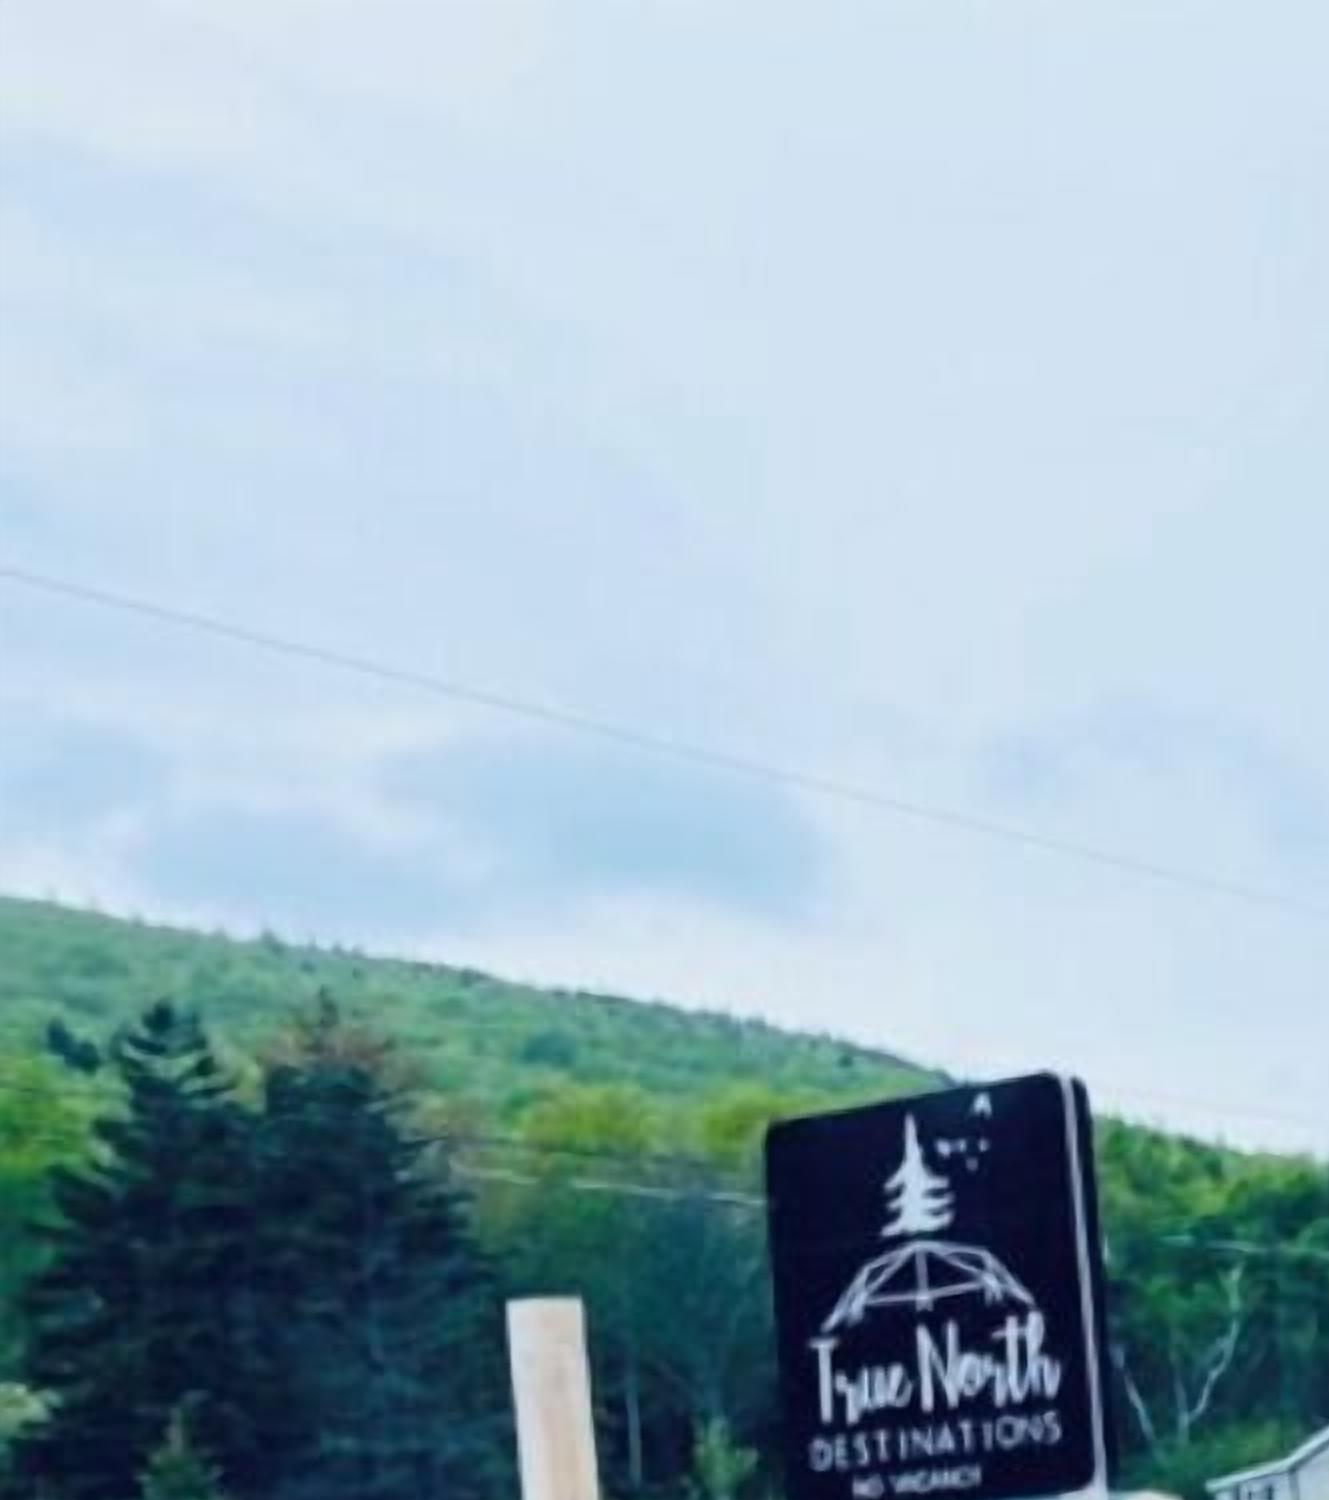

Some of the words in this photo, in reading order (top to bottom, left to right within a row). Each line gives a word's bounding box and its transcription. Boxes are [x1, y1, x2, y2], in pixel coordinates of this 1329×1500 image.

[809, 1336, 912, 1425] True
[915, 1310, 1061, 1413] North
[808, 1410, 1062, 1472] DESTINATIONS
[852, 1472, 885, 1499] NO
